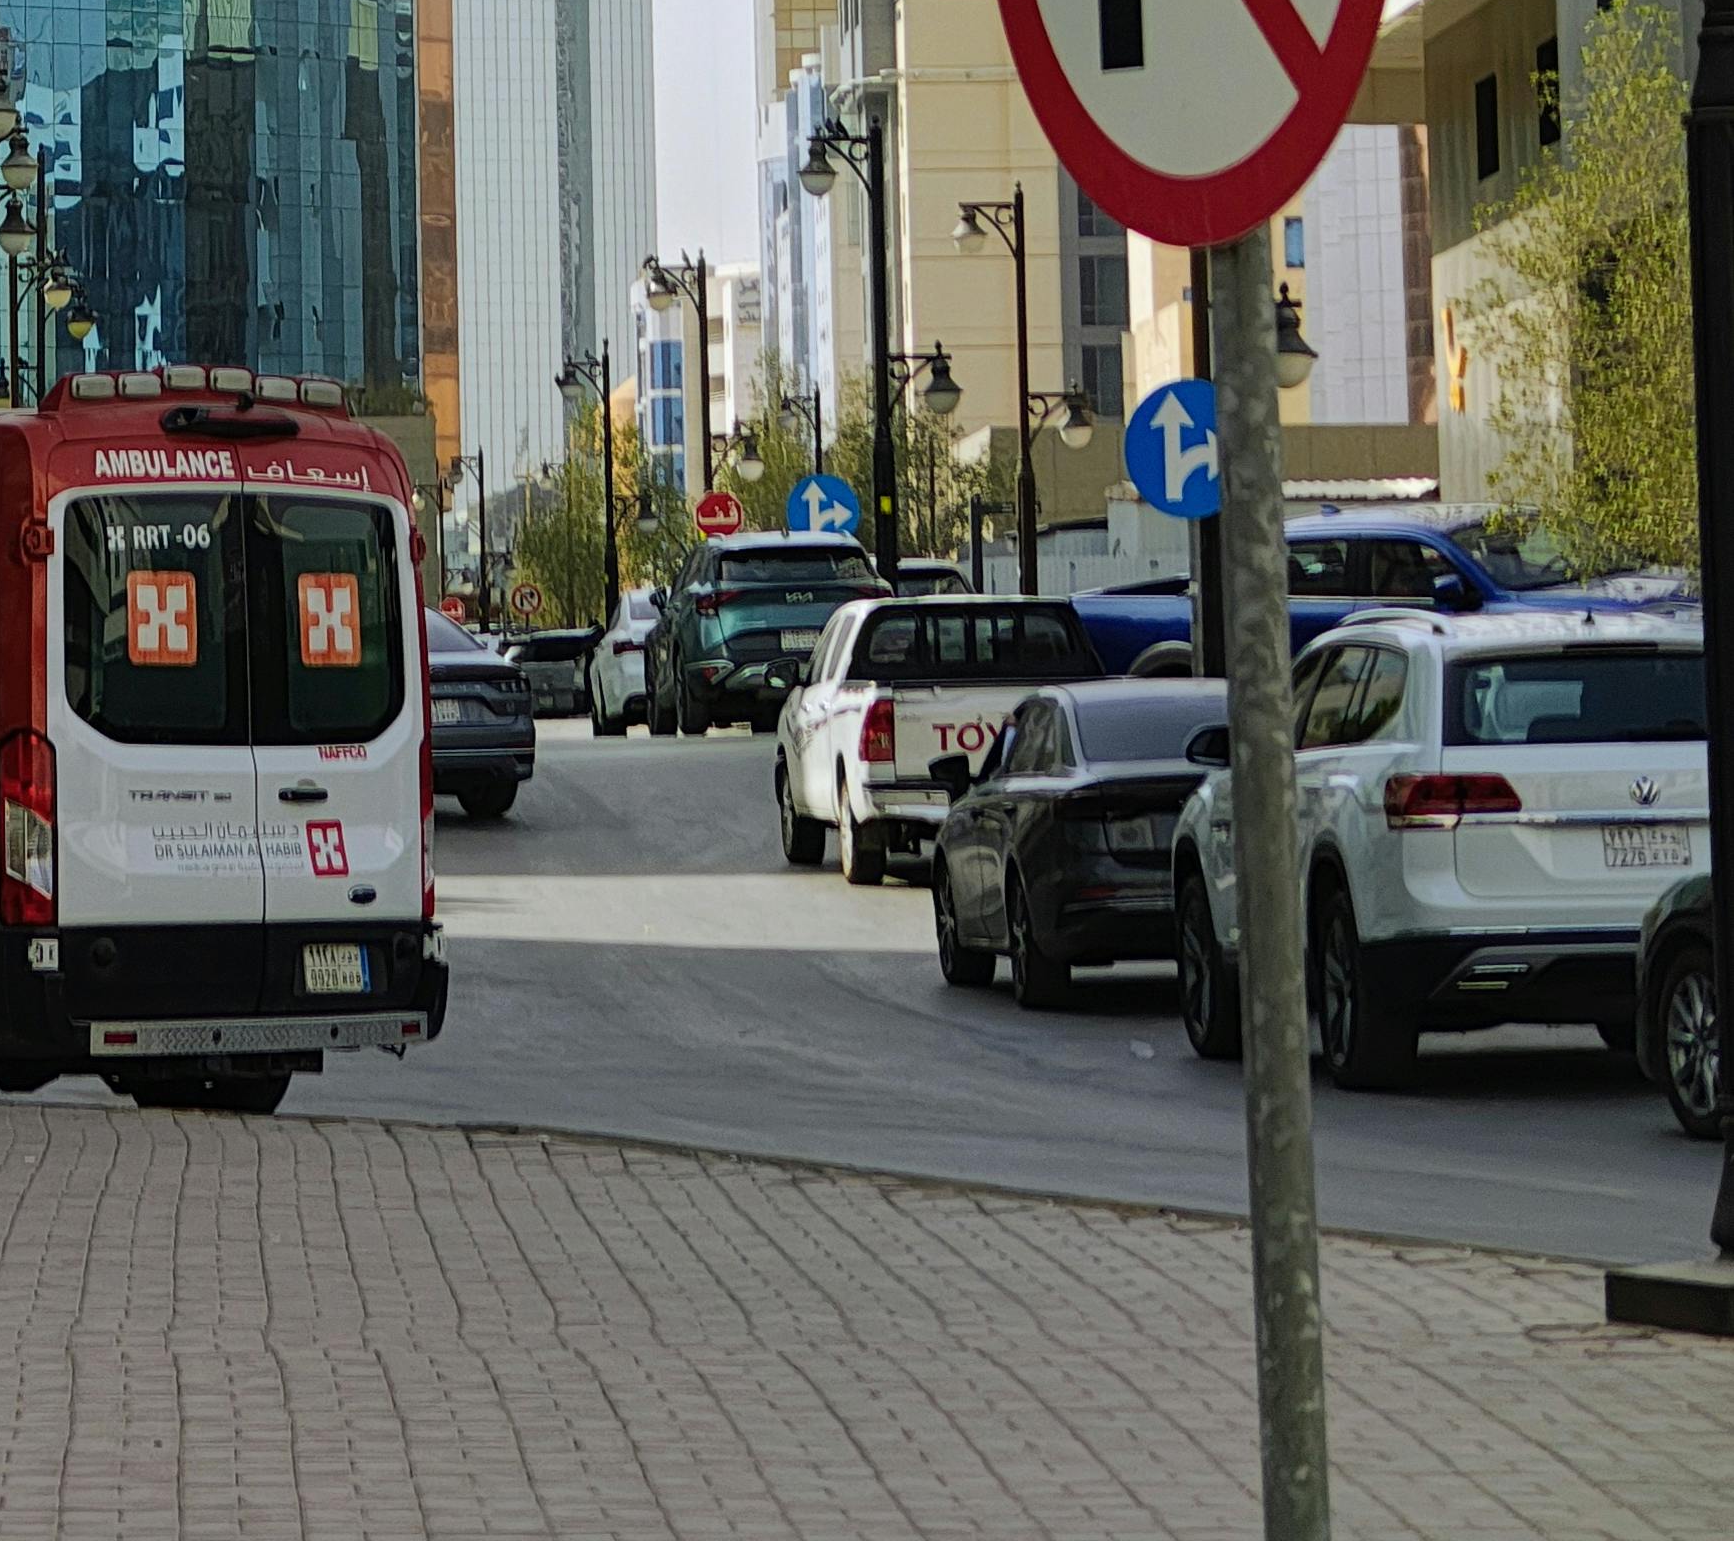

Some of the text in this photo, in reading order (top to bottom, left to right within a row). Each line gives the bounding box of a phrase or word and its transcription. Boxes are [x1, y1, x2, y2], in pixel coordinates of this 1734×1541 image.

[95, 449, 235, 478] AMBULANCE
[247, 460, 371, 493] إسعاف
[133, 525, 170, 550] RRT
[318, 745, 367, 761] NAFFCO
[154, 843, 174, 860] DR
[177, 843, 243, 859] SULAIMAN
[266, 842, 302, 858] HABIB
